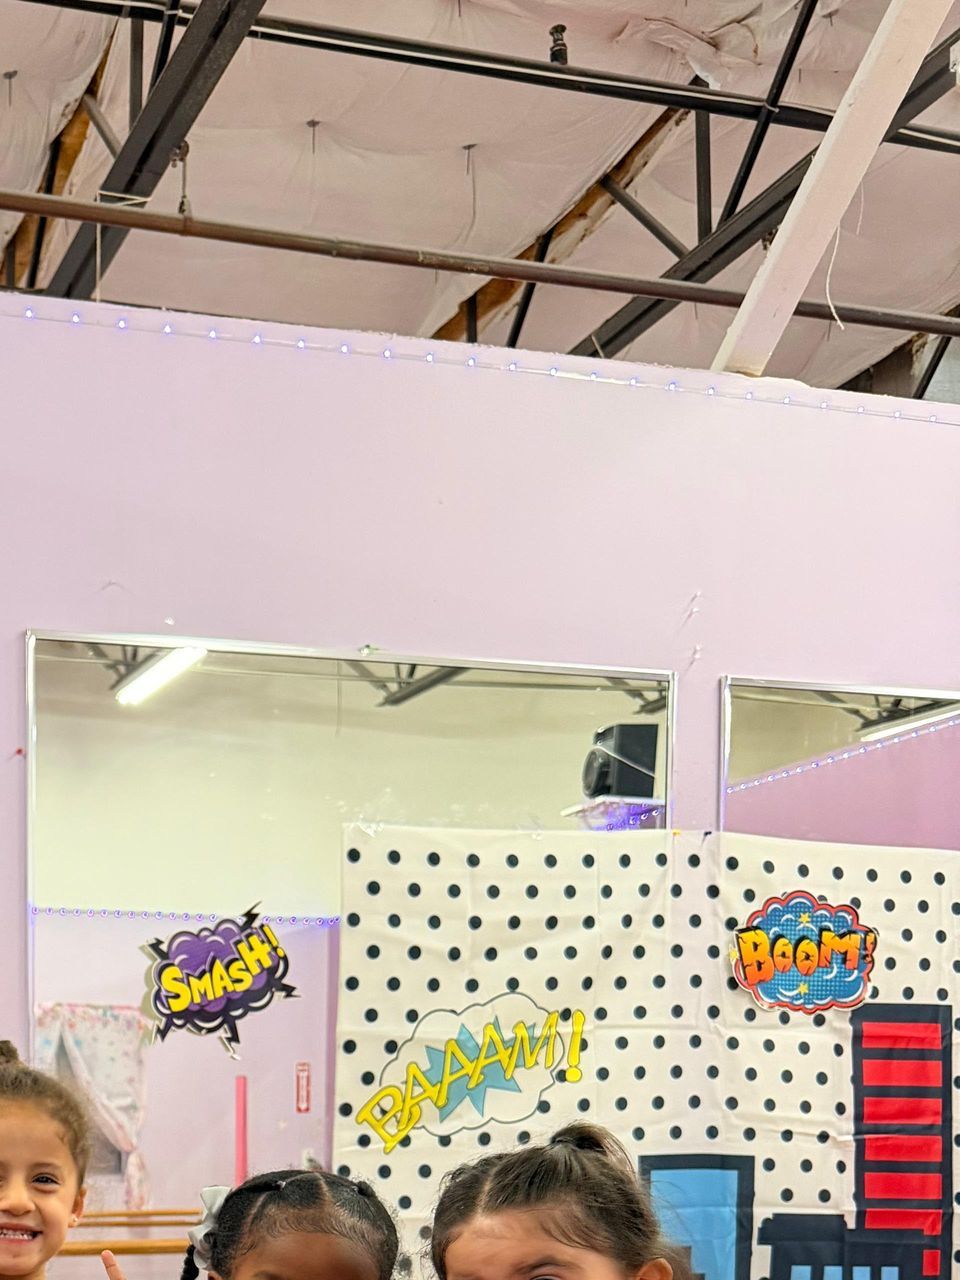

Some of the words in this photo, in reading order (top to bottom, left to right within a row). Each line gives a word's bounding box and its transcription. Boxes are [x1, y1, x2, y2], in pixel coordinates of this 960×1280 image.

[159, 923, 287, 1013] SMASH!
[735, 926, 877, 986] BOOM!
[355, 1008, 586, 1154] BAAAM!
